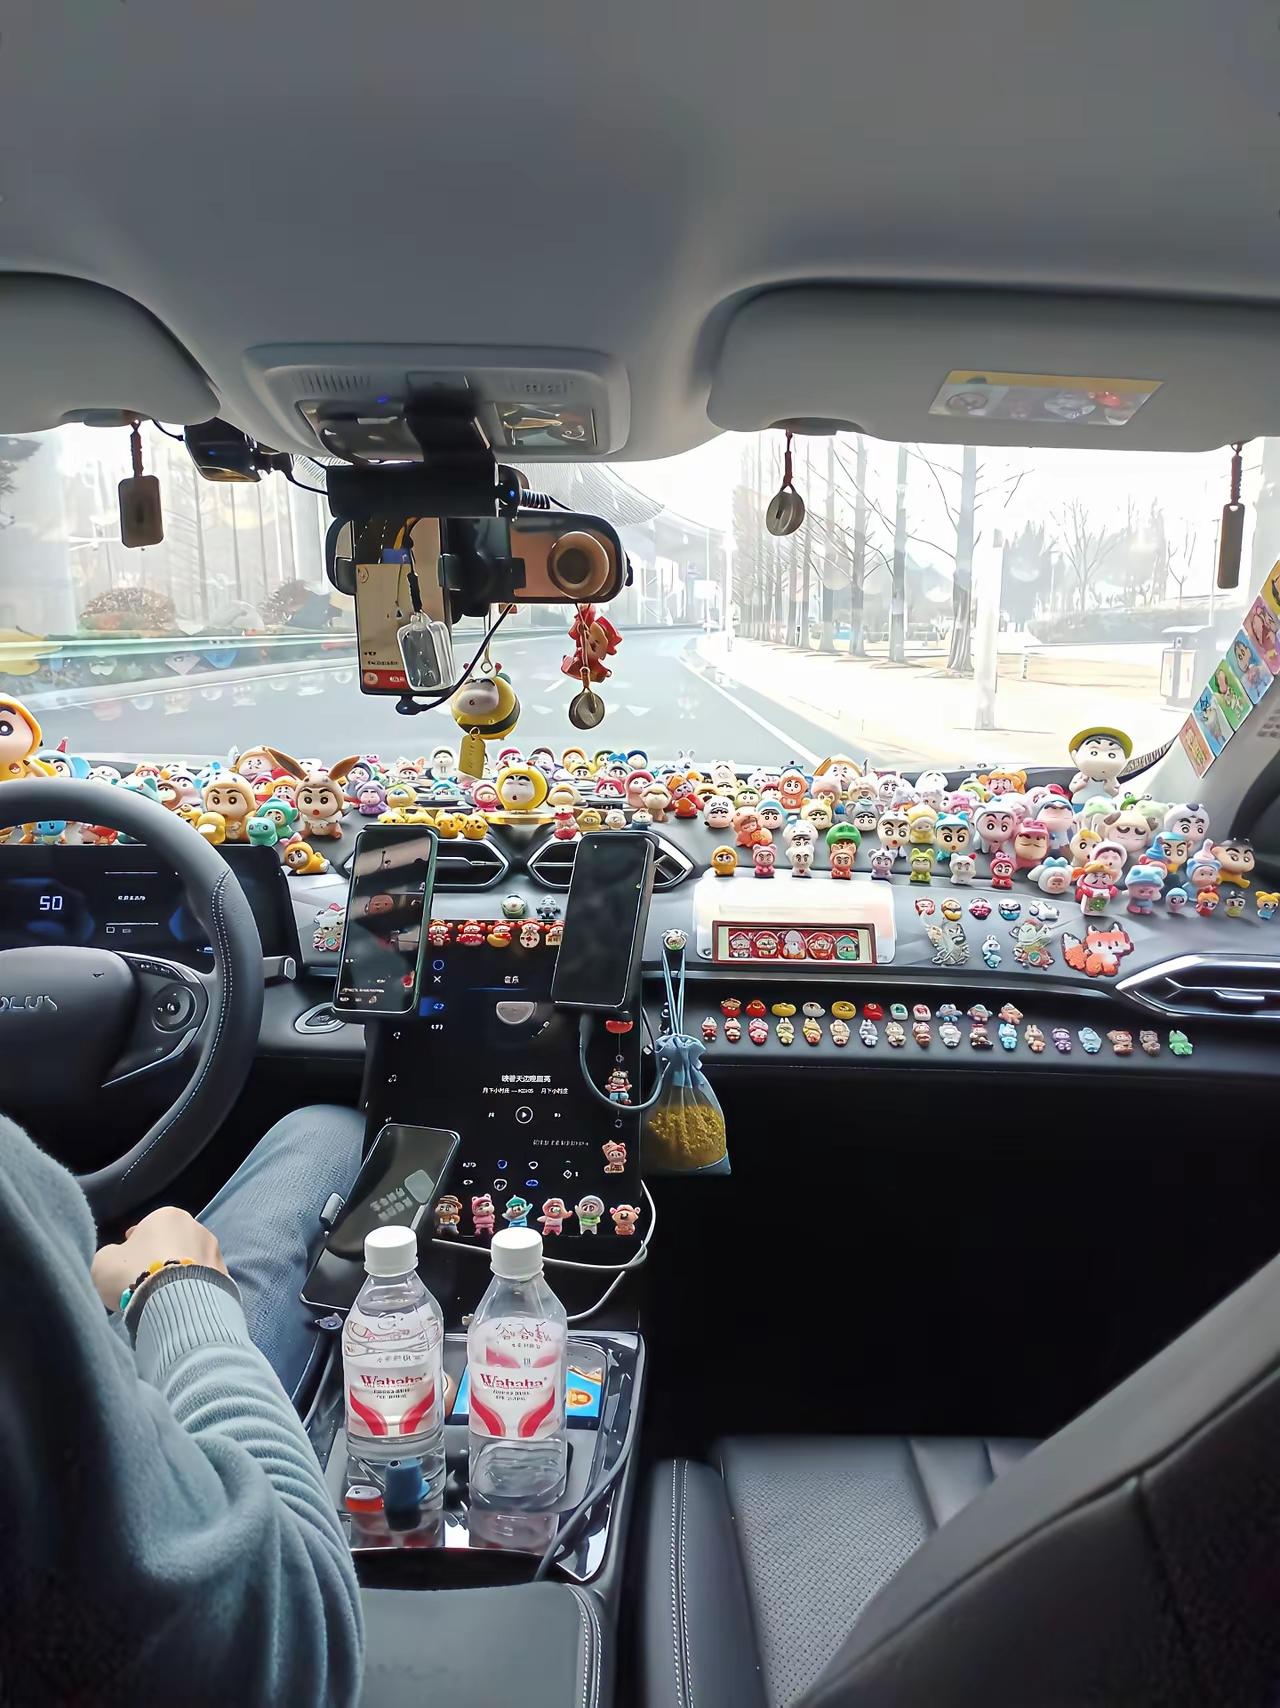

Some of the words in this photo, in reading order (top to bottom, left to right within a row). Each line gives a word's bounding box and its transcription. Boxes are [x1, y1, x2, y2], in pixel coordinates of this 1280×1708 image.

[40, 896, 63, 911] 50
[360, 1374, 423, 1388] Wahaha
[480, 1373, 543, 1389] Wahaha
